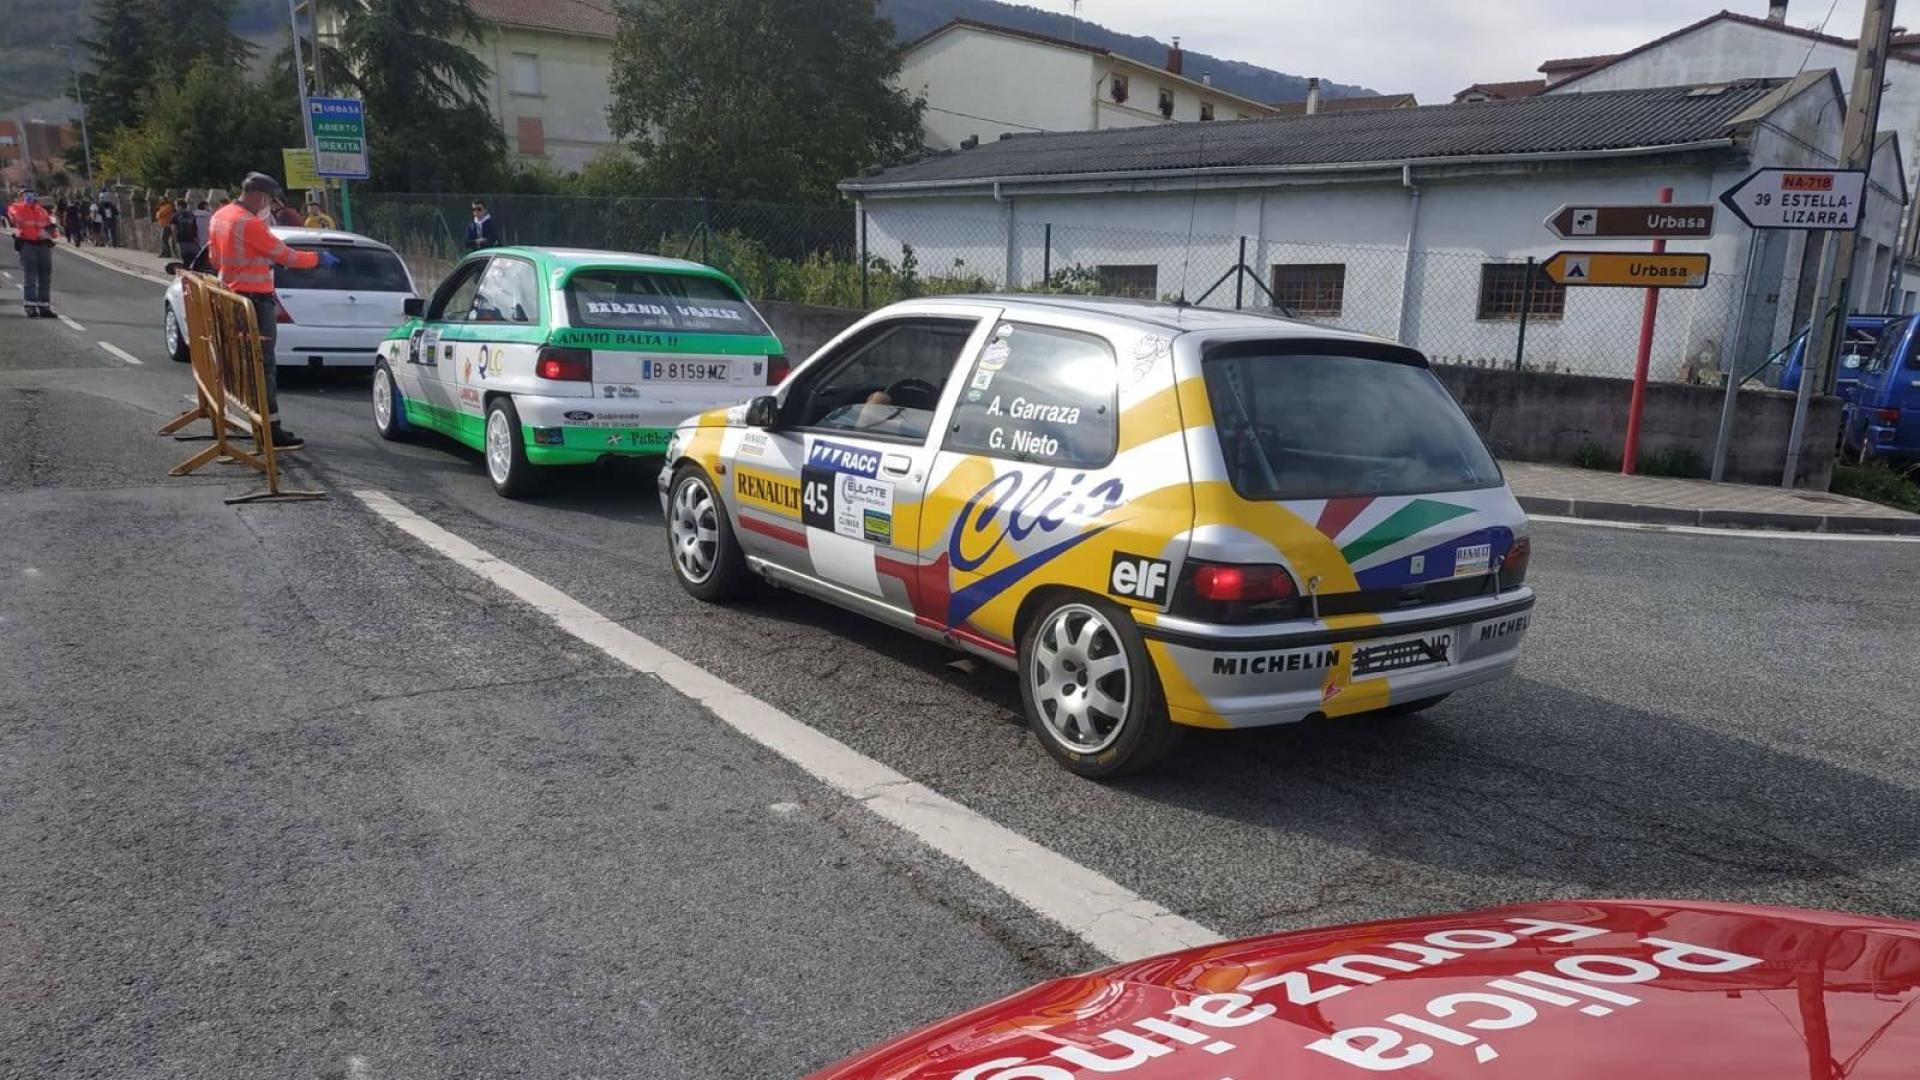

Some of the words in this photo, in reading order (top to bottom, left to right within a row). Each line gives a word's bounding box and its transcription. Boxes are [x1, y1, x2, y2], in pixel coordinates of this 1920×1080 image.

[318, 123, 358, 132] ABIERTO
[1783, 176, 1831, 189] NA-718
[1754, 193, 1771, 206] 39
[1781, 194, 1853, 208] ESTELLA-
[1647, 214, 1706, 229] Urbasa
[1782, 210, 1849, 225] LIZARRA
[1629, 263, 1688, 277] Urbasa
[558, 332, 610, 345] ANIMO
[616, 334, 662, 346] BALTA
[987, 395, 1004, 417] A.
[1010, 396, 1080, 425] Garraza
[989, 427, 1006, 450] G.
[1011, 429, 1059, 456] Nieto
[840, 449, 878, 474] RACC
[737, 472, 800, 511] RENAULT
[803, 480, 829, 516] 45
[949, 467, 1127, 572] Clio
[1112, 560, 1166, 599] elf
[1212, 649, 1340, 676] MICHELIN
[1304, 937, 1765, 1071] Policía
